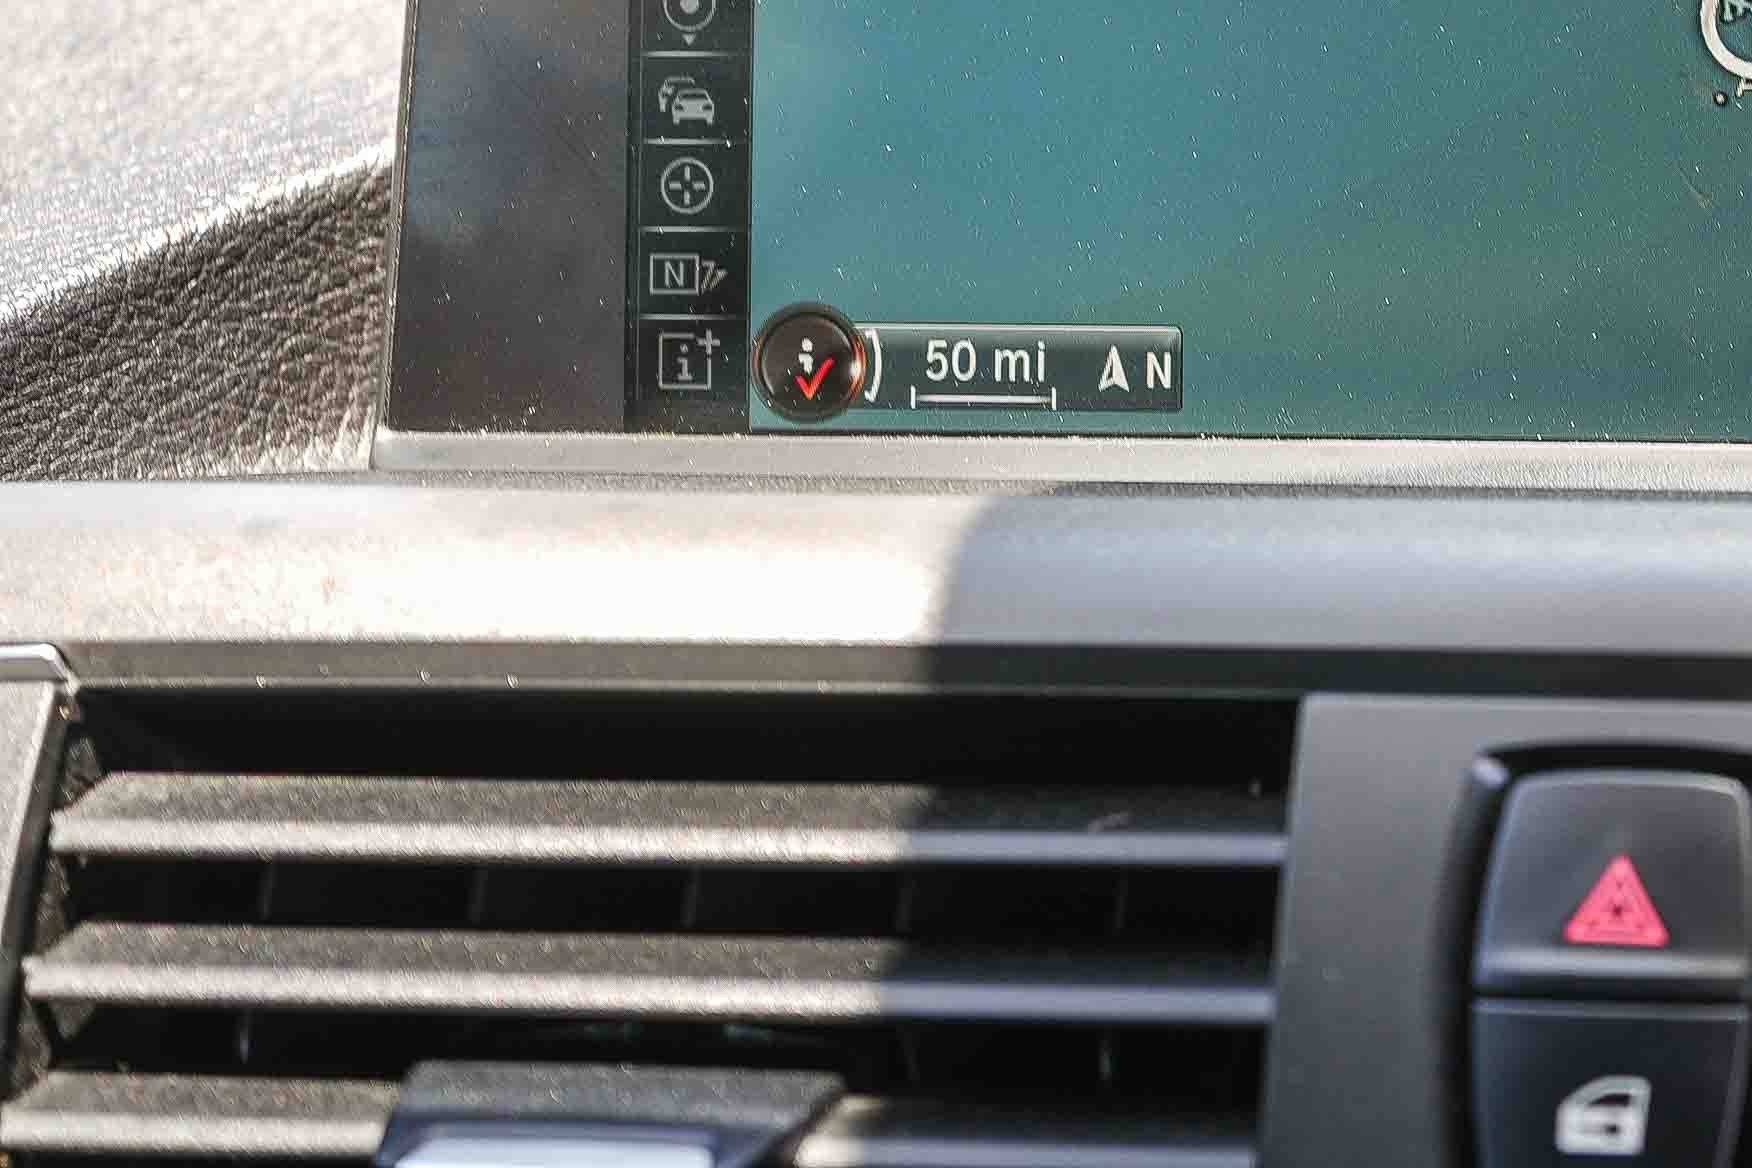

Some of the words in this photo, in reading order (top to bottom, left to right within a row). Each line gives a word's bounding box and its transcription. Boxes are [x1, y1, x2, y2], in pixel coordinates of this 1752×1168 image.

[663, 260, 686, 288] N
[924, 340, 977, 382] 50
[993, 340, 1046, 384] mi
[1146, 352, 1173, 390] N
